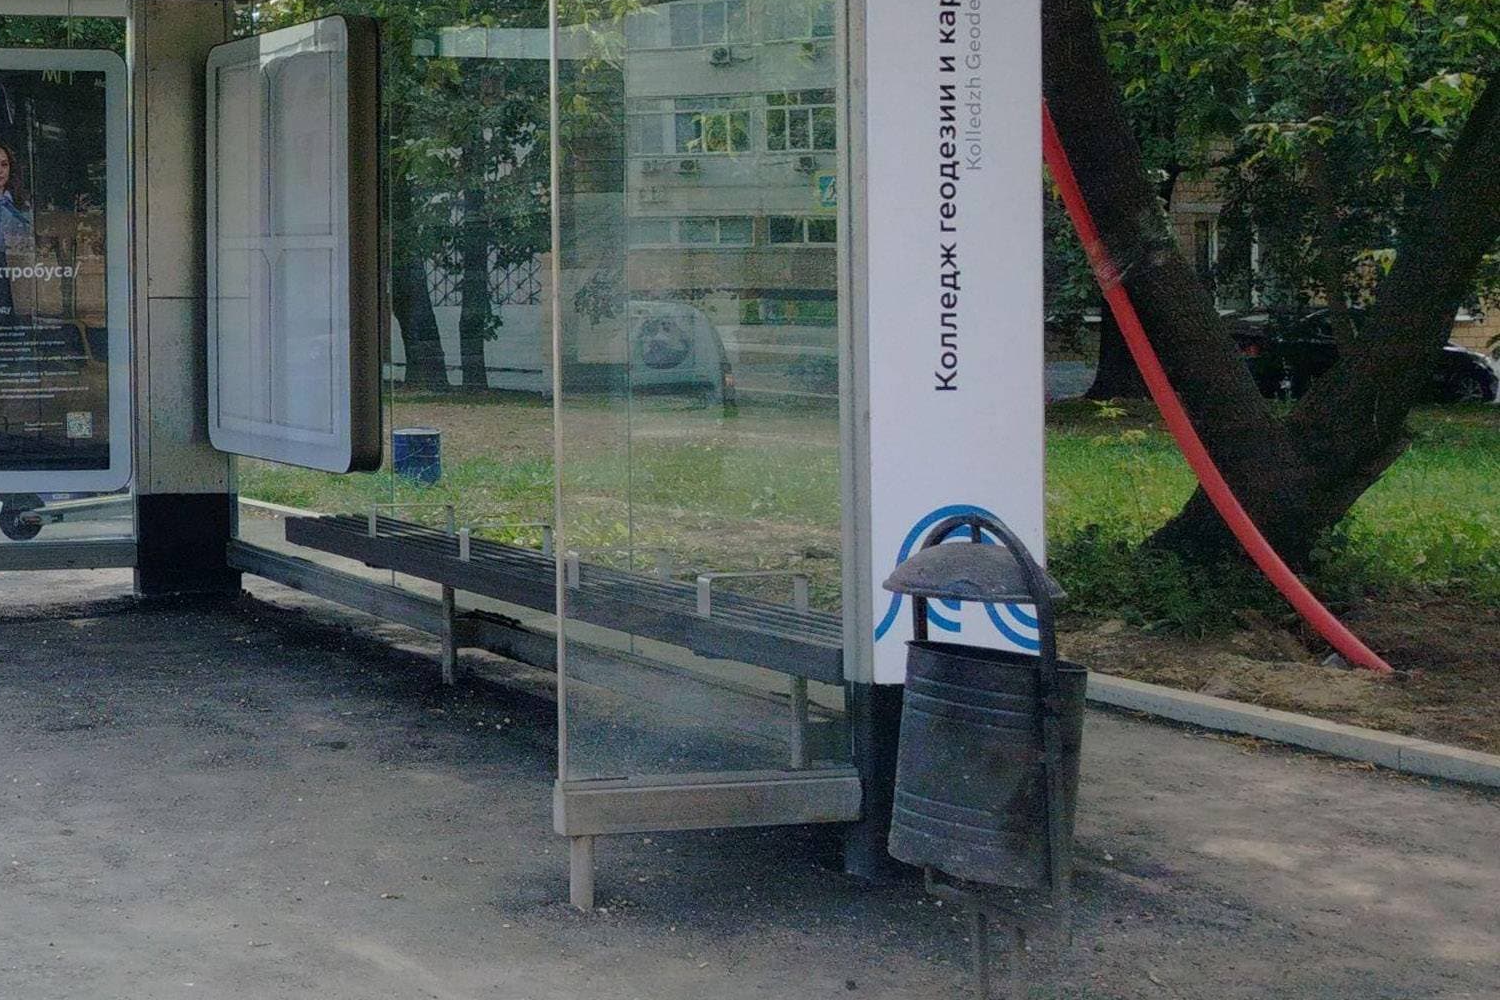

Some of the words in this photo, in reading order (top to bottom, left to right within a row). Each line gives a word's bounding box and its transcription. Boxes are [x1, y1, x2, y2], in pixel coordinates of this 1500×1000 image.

[938, 56, 956, 73] и
[963, 76, 982, 171] Kolledzh
[939, 84, 960, 233] геодезии
[934, 242, 961, 391] Колледж
